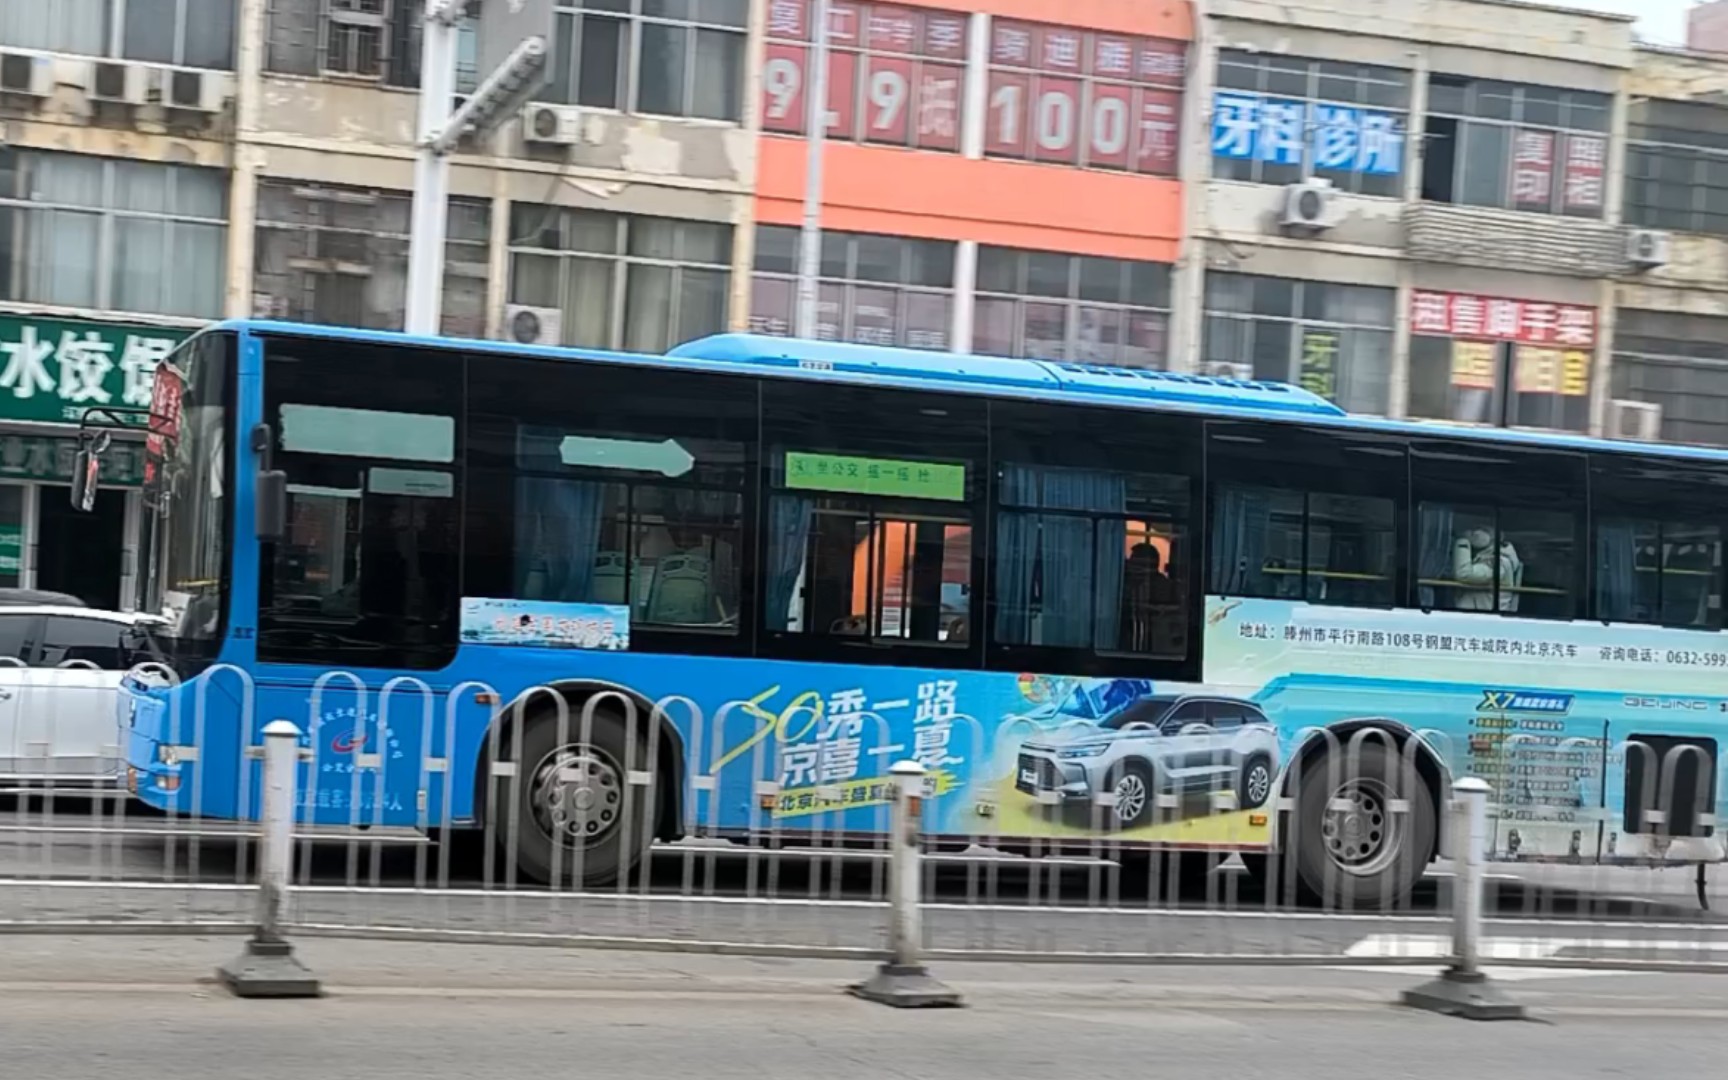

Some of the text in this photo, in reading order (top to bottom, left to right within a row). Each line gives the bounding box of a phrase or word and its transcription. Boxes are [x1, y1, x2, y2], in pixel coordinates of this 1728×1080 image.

[1213, 92, 1405, 172] 牙科诊所
[1481, 692, 1516, 709] X7
